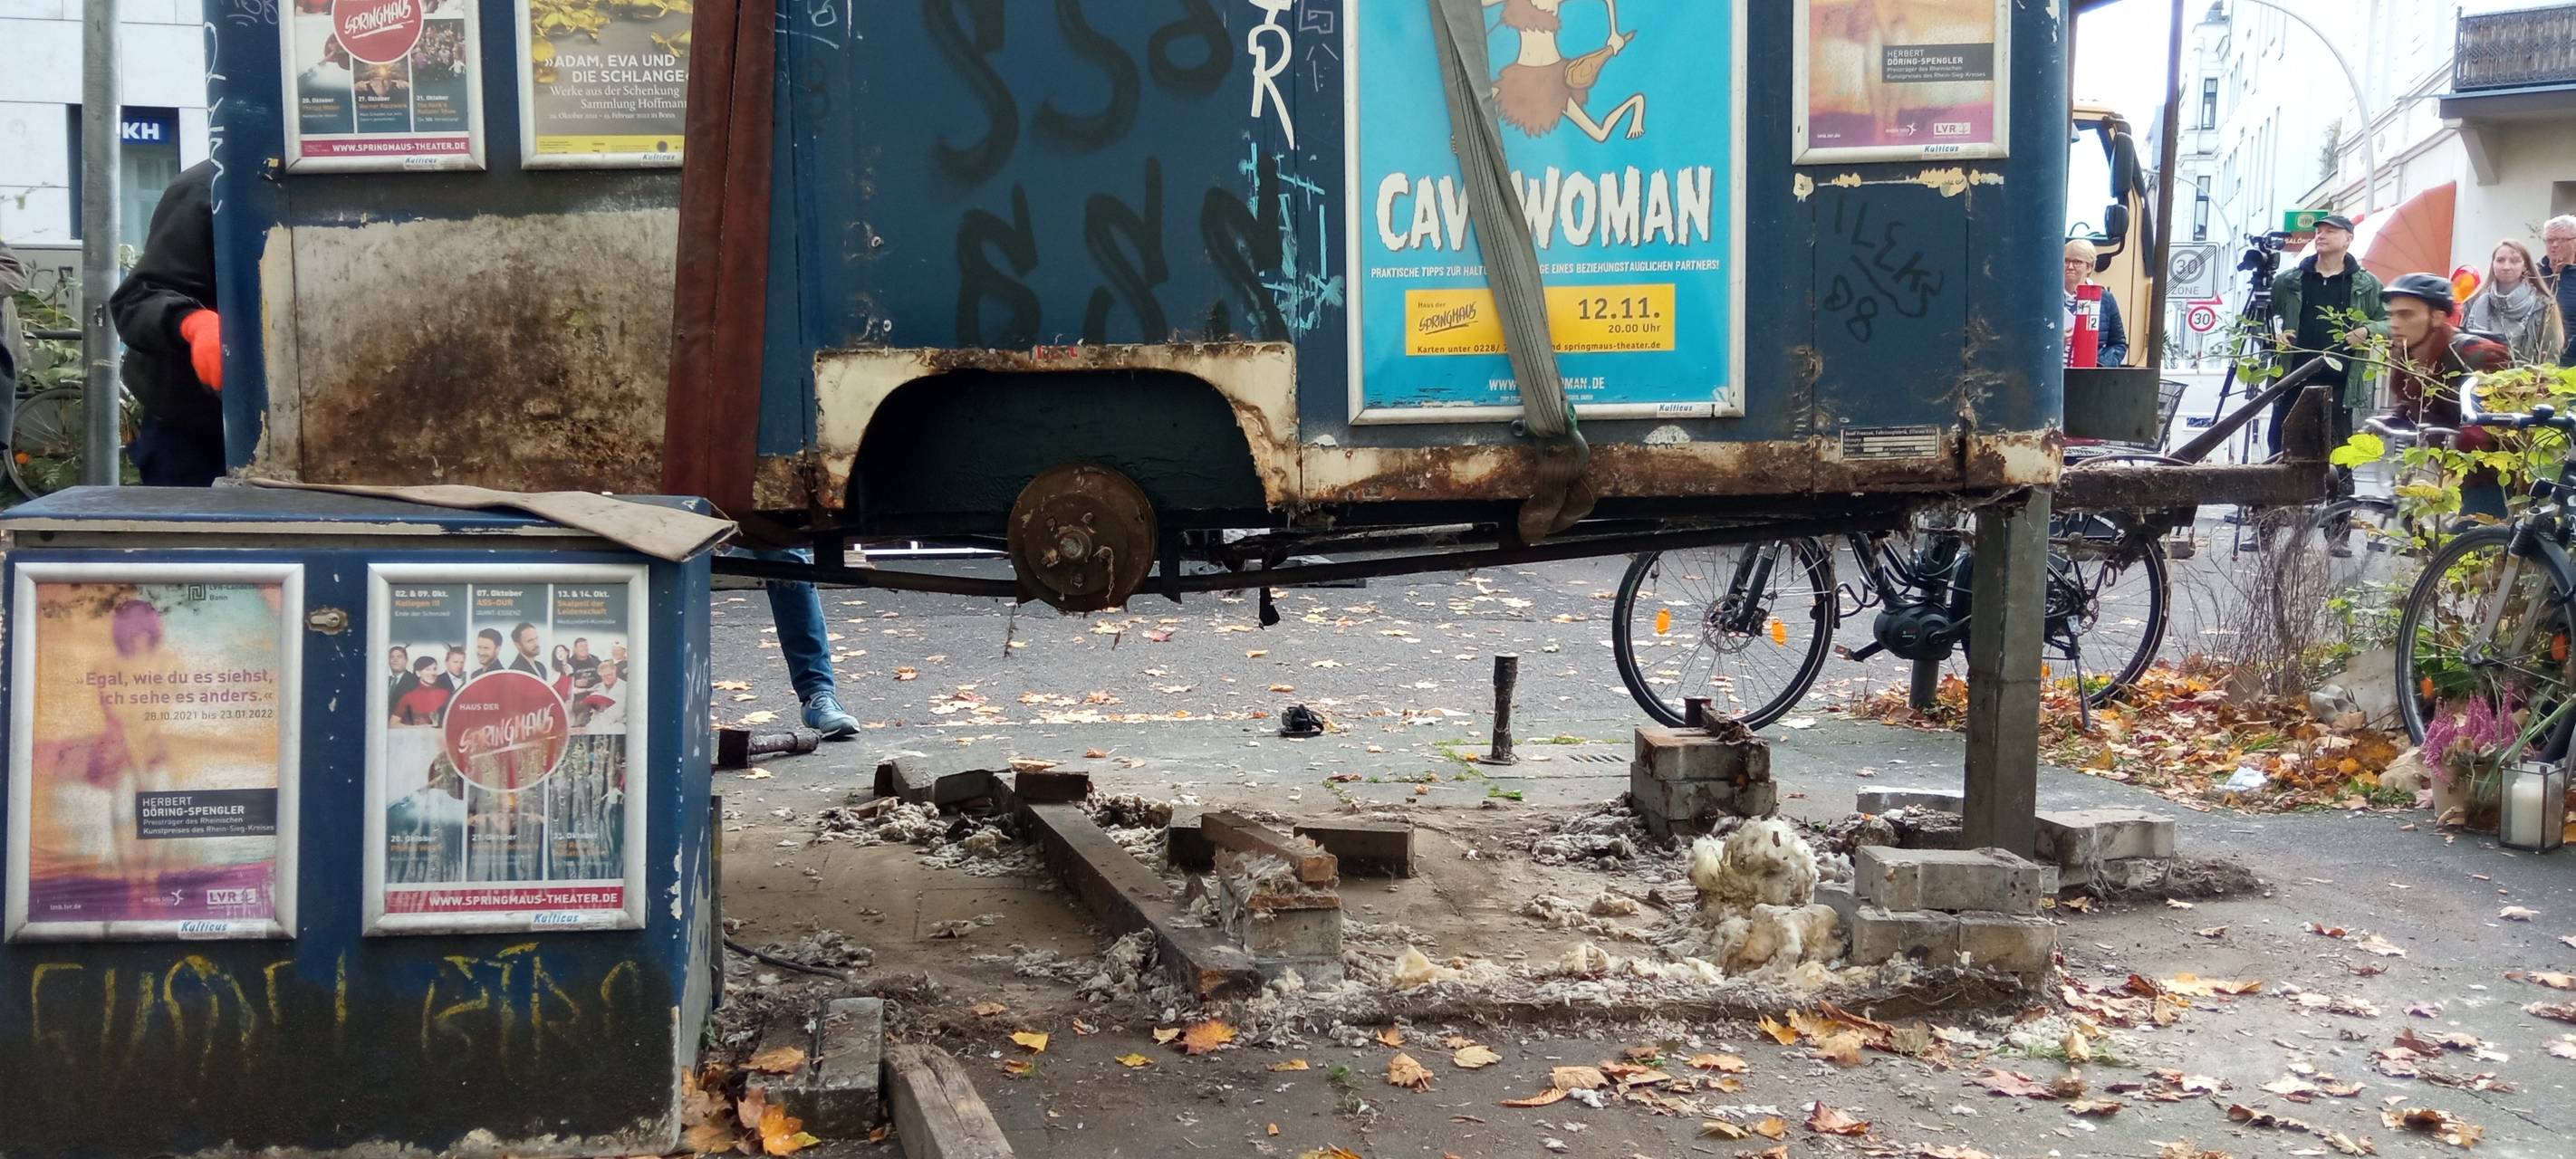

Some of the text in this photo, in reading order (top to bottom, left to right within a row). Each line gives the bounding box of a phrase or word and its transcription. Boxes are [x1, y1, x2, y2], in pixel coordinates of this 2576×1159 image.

[1888, 50, 1924, 58] HERBERT
[608, 54, 638, 67] EVA
[643, 54, 676, 67] UND
[572, 71, 597, 82] DIE
[550, 85, 680, 98] Werke aus der Schenkung
[580, 99, 636, 110] Sammlung
[1935, 125, 1956, 133] LVR
[332, 141, 466, 153] WWW.SPRINGMAUS-THEATER.DE
[1376, 166, 1712, 251] CAVWOMAN
[1552, 263, 1574, 273] EINES
[1576, 261, 1674, 273] BEZIEHUNGSTAUGLICHEN
[1676, 260, 1719, 270] PARTNERS!
[2176, 259, 2197, 273] 30
[1371, 267, 1419, 279] PRAKTISCHE
[1422, 266, 1444, 277] TIPPS
[1447, 266, 1461, 276] ZUR
[1578, 297, 1660, 320] 12.11.
[2091, 318, 2096, 328] 2
[2194, 313, 2210, 325] 30
[1609, 323, 1661, 333] 20.00 Uhr
[1474, 344, 1500, 353] 0228/
[1564, 340, 1661, 351] springmaus-theater.de
[476, 589, 524, 598] 07. Oktober
[76, 668, 274, 688] »Egal, wie du es siehst,
[100, 690, 274, 704] ich sehe es anders.«
[144, 709, 274, 721] 28.10.2021 bis 23.01.2022
[142, 797, 193, 807] HERBERT
[142, 805, 245, 818] DÖRING-SPENGLER
[143, 817, 244, 827] Preisträger des Rheinischen
[207, 824, 275, 834] Rhein-Sieg-Kreises
[209, 892, 237, 904] LVR
[429, 893, 618, 906] WWW.SPRINGMAUS-THEATER.DE
[533, 913, 578, 924] Kulticus
[181, 922, 228, 933] Kulticus
